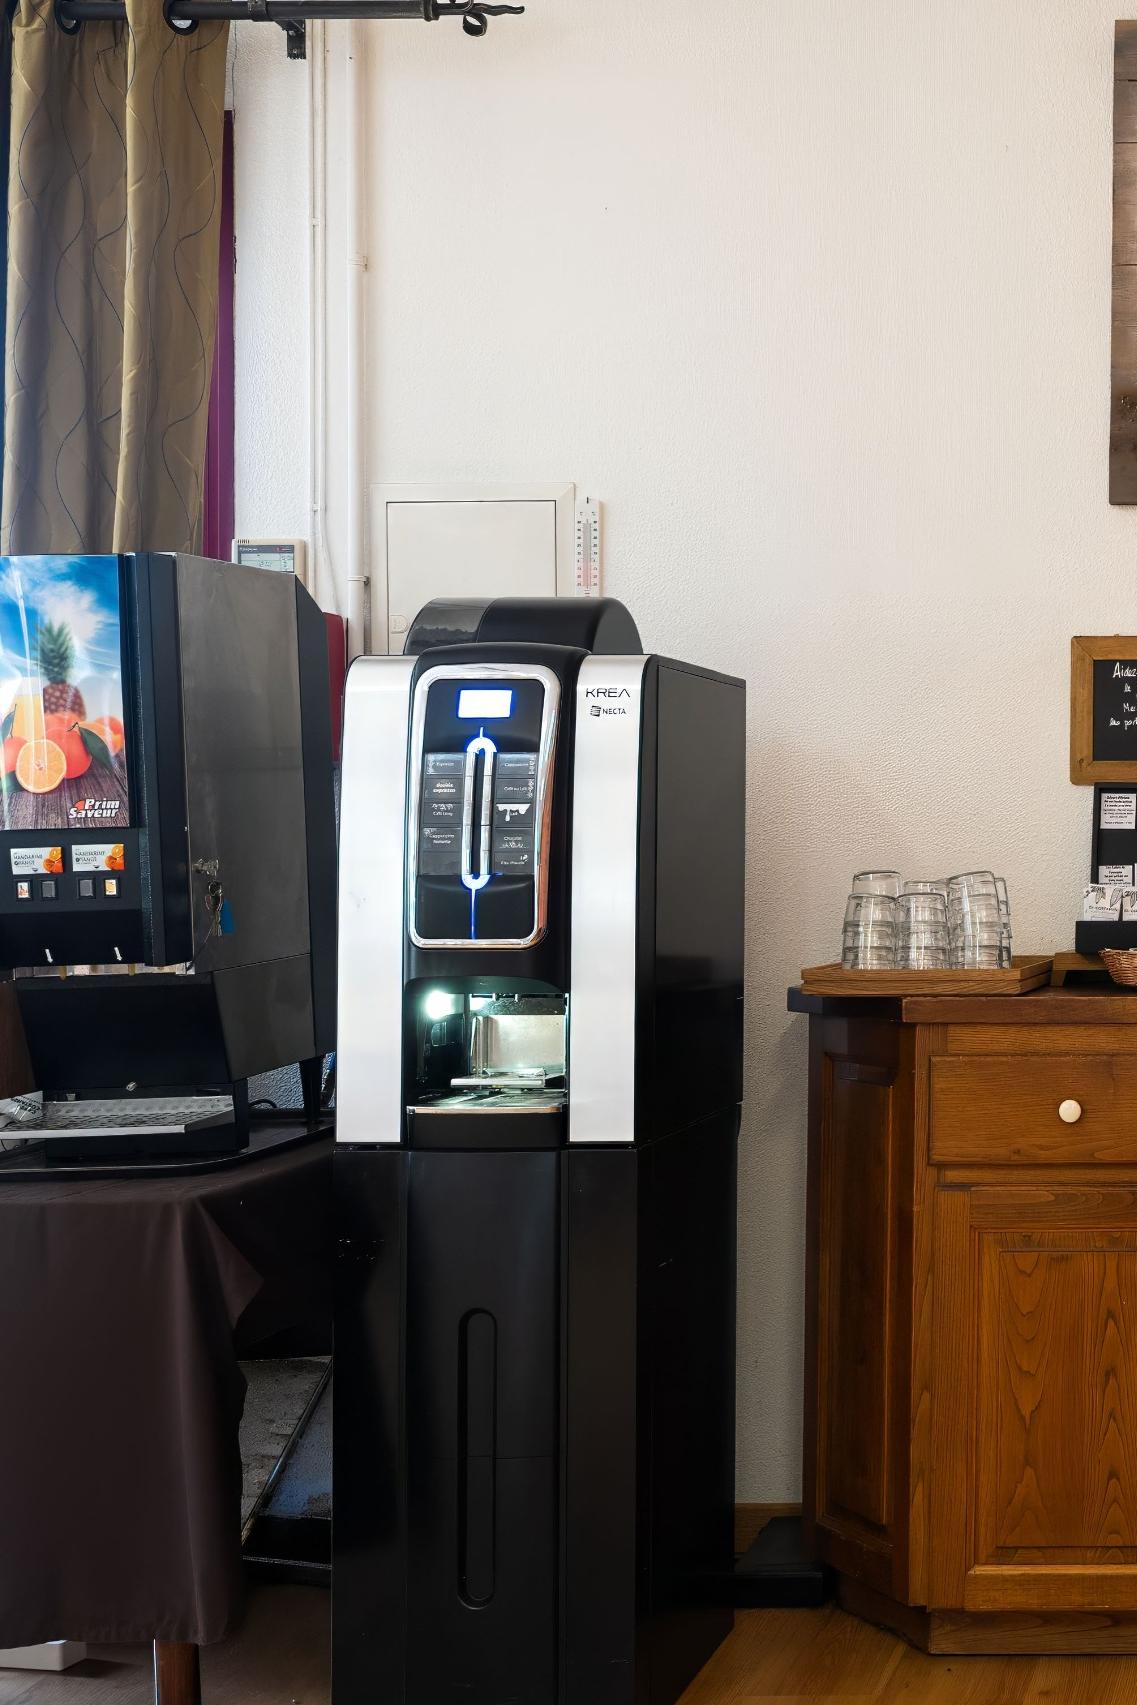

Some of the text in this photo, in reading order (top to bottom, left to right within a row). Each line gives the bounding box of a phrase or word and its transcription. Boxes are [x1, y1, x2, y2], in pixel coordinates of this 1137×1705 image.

[585, 687, 631, 698] KREA
[84, 798, 120, 810] Prim
[68, 807, 119, 818] Saveur
